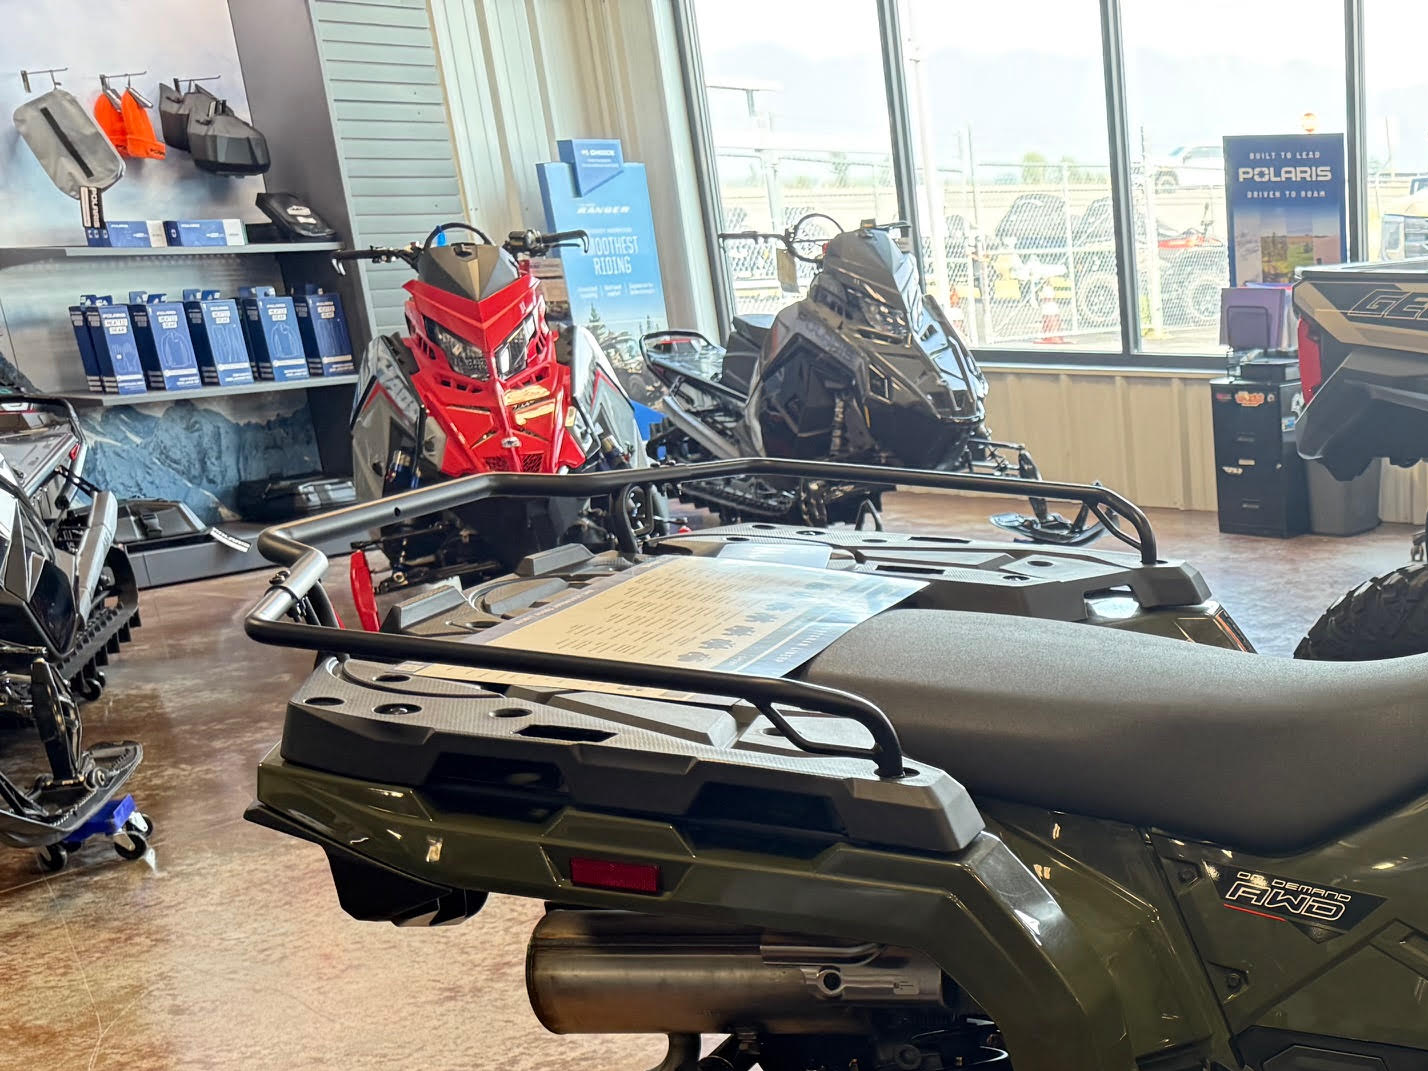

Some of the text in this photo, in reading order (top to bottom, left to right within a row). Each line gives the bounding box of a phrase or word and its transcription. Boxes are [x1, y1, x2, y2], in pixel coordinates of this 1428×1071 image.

[1249, 152, 1276, 160] BUILT
[1296, 151, 1321, 159] LEAD
[1238, 166, 1333, 182] POLARIS
[1285, 190, 1297, 198] TO
[584, 235, 639, 256] MOOTHEST
[593, 256, 633, 276] RIDING
[1272, 879, 1352, 902] DEMAND
[1225, 881, 1346, 921] AWD
